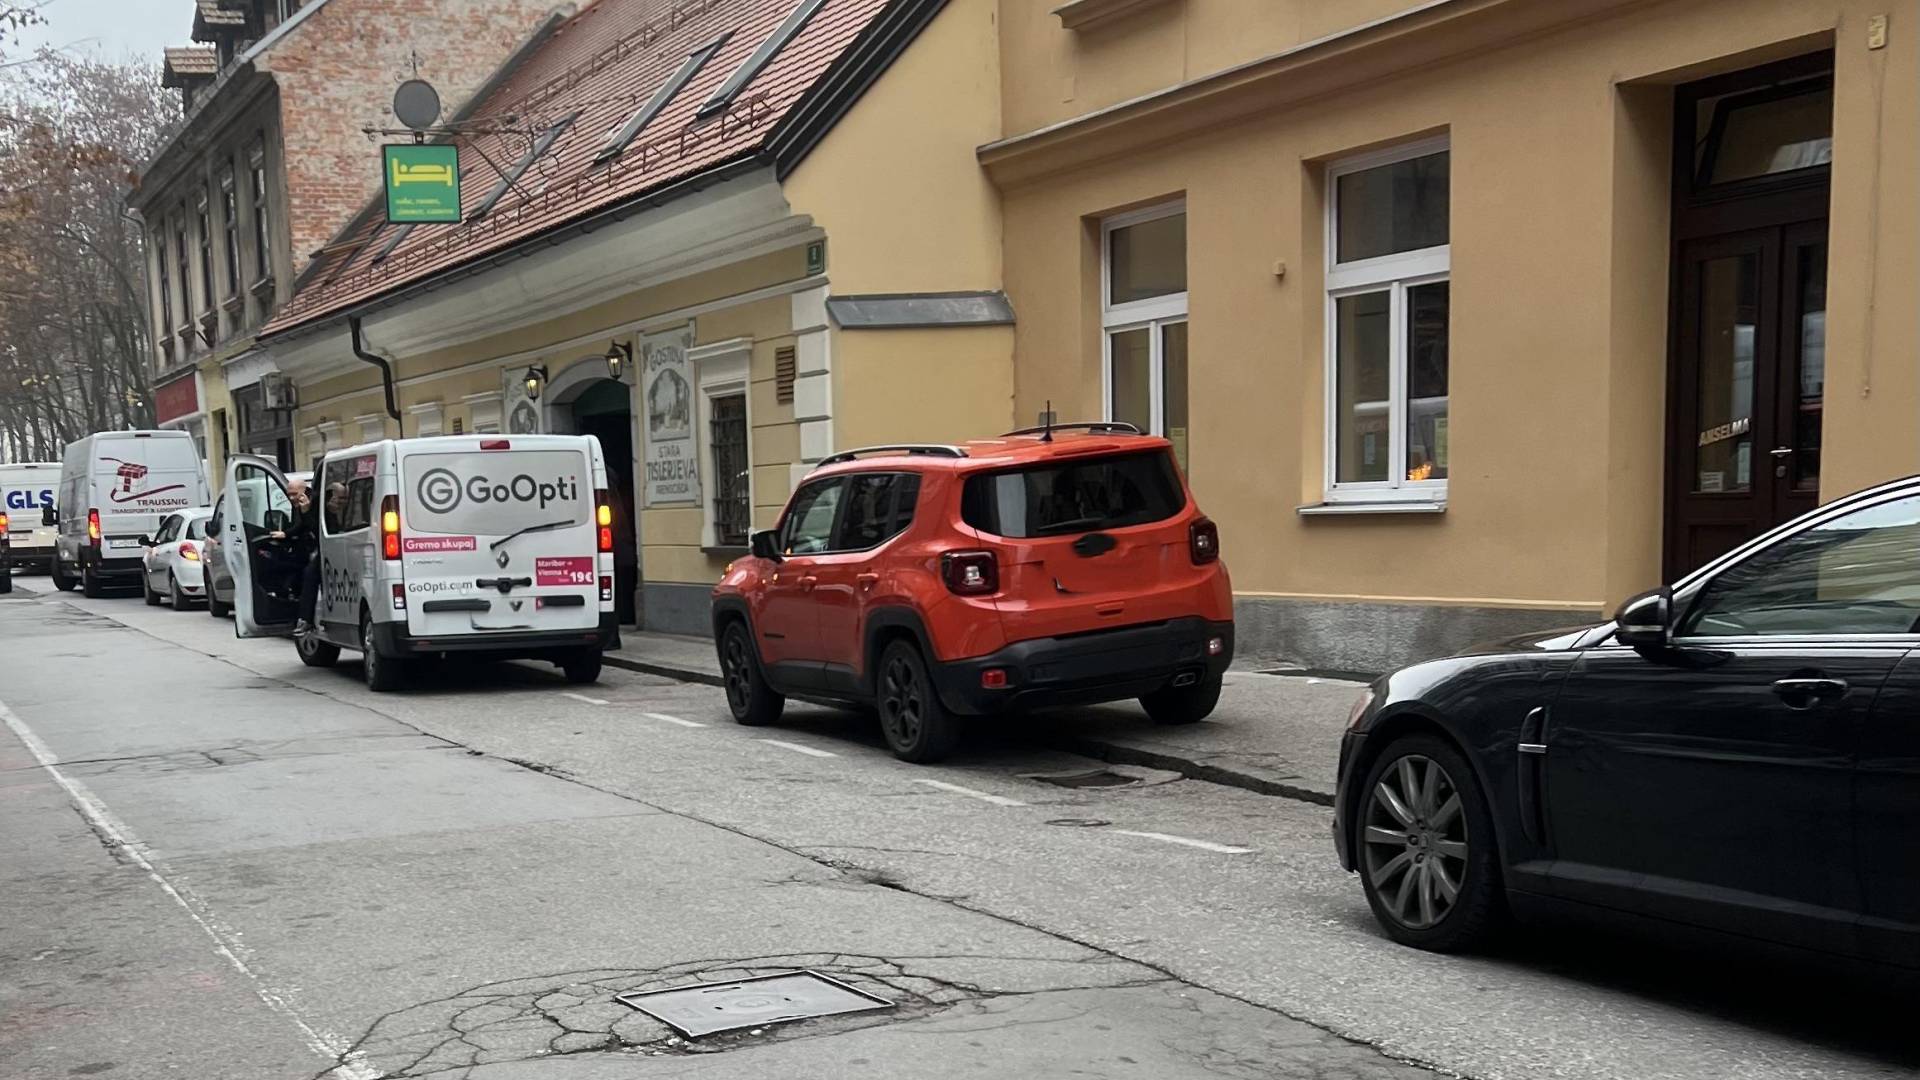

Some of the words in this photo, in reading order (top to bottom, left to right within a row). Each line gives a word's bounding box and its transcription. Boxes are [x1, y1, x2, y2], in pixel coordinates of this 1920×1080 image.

[1699, 418, 1749, 446] ANSELMA
[6, 490, 54, 510] GLS
[466, 474, 577, 509] GoOpti
[406, 540, 440, 550] Gremo
[441, 538, 474, 550] skupaj
[569, 571, 593, 583] 19€
